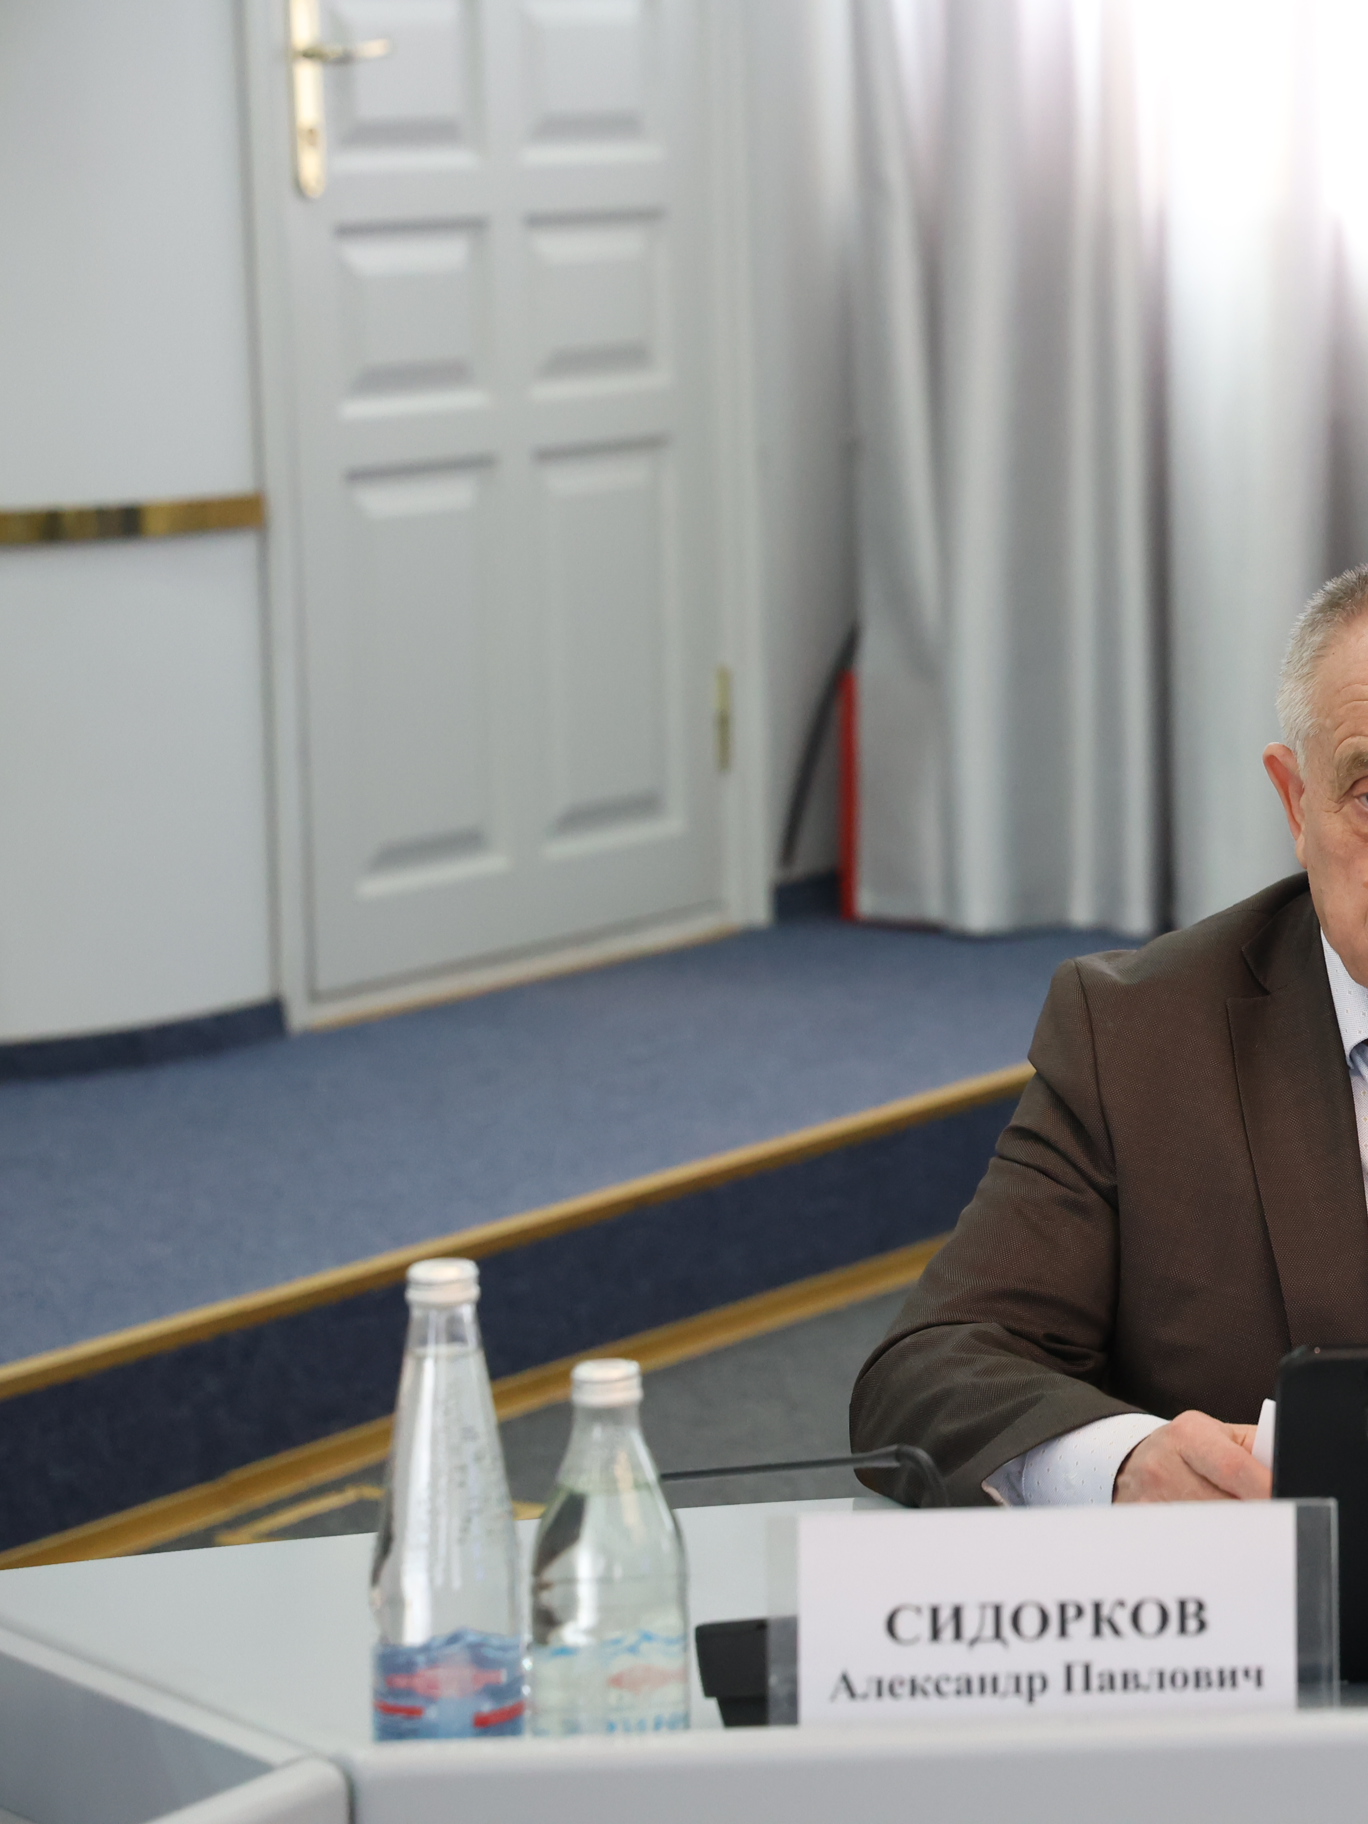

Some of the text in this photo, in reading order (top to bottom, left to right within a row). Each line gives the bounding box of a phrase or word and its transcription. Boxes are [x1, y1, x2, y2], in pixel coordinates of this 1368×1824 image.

[885, 1597, 1209, 1649] СИДОРКОВ
[829, 1660, 1265, 1706] Александр Павлович
